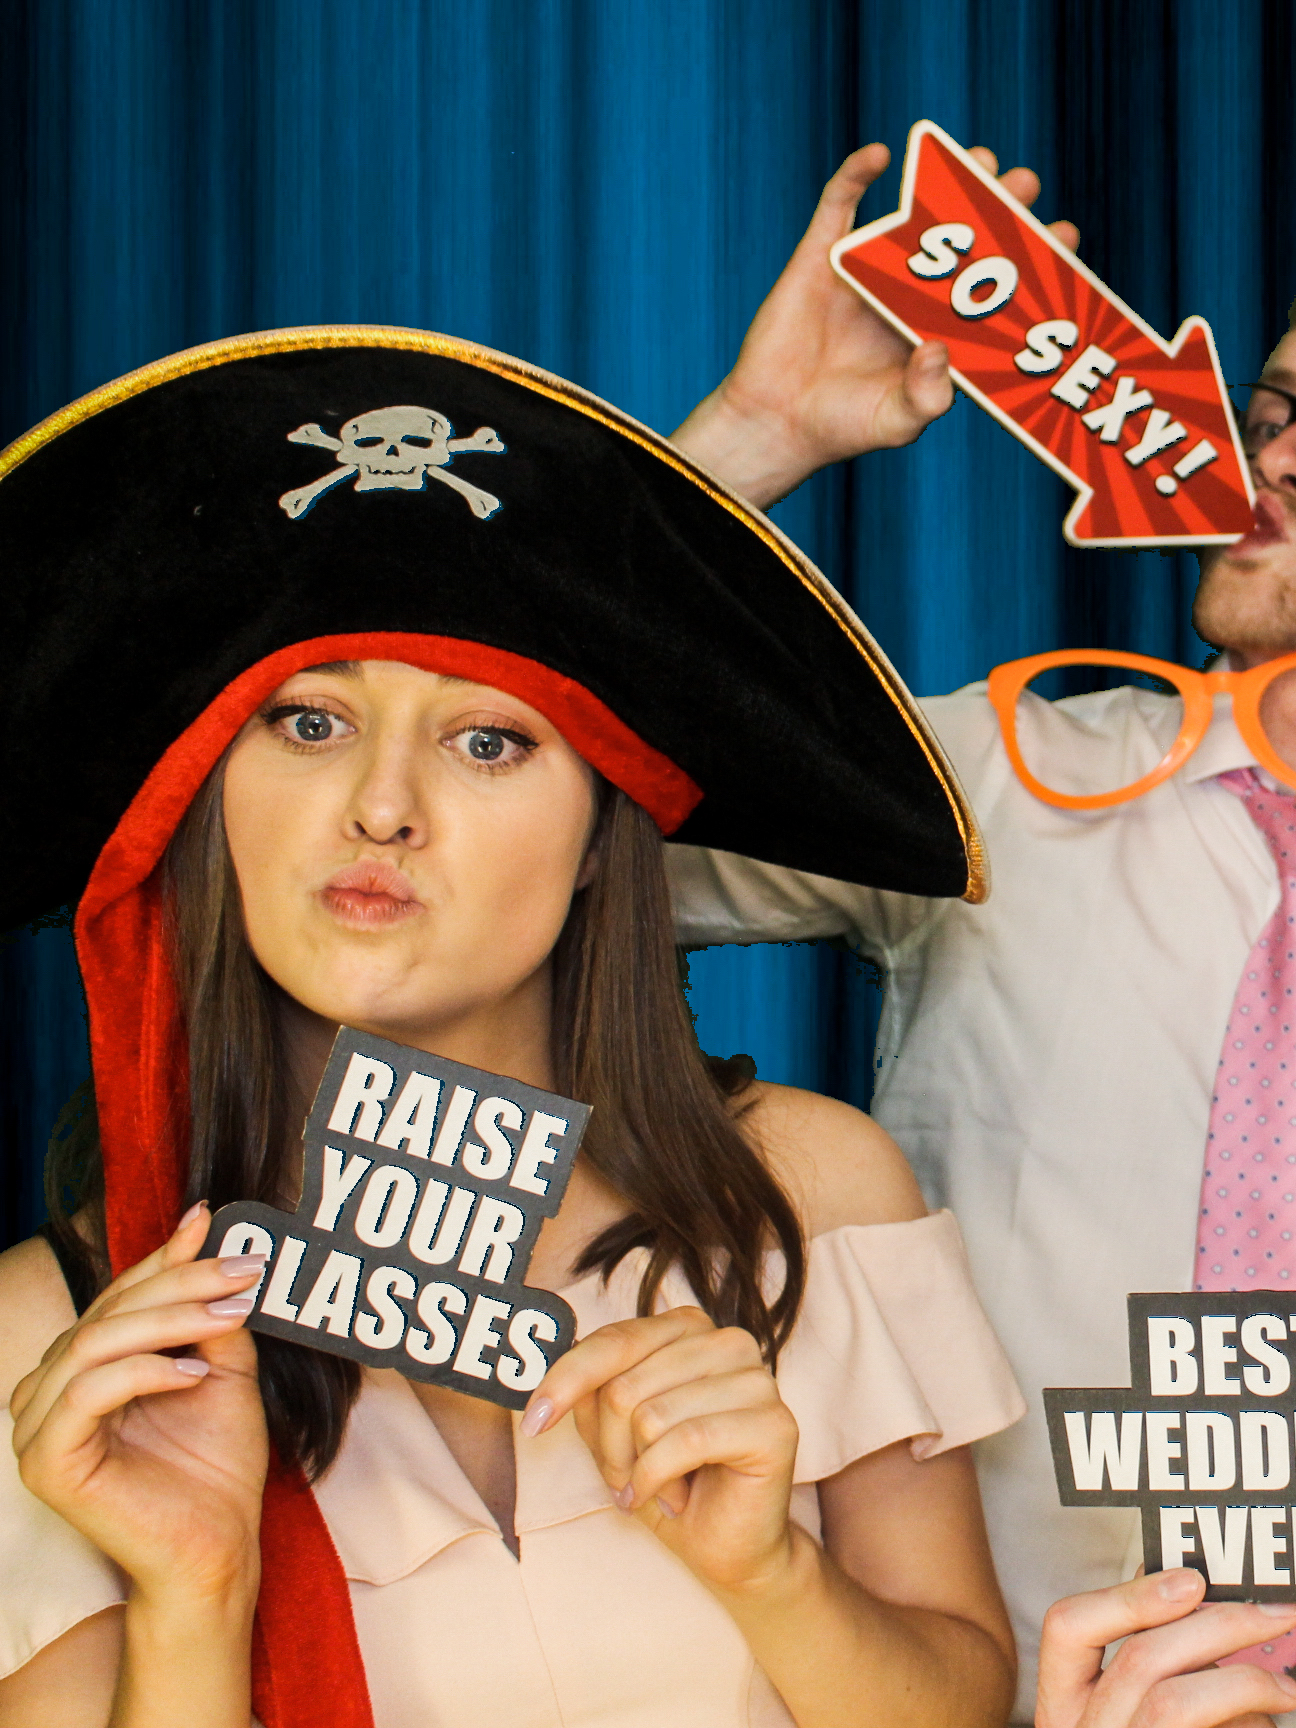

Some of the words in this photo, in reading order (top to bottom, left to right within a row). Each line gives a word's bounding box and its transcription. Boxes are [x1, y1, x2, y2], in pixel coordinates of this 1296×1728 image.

[907, 222, 1019, 319] SO
[1013, 318, 1219, 496] SEXY!
[326, 1051, 571, 1197] RAISE
[312, 1144, 526, 1285] YOUR
